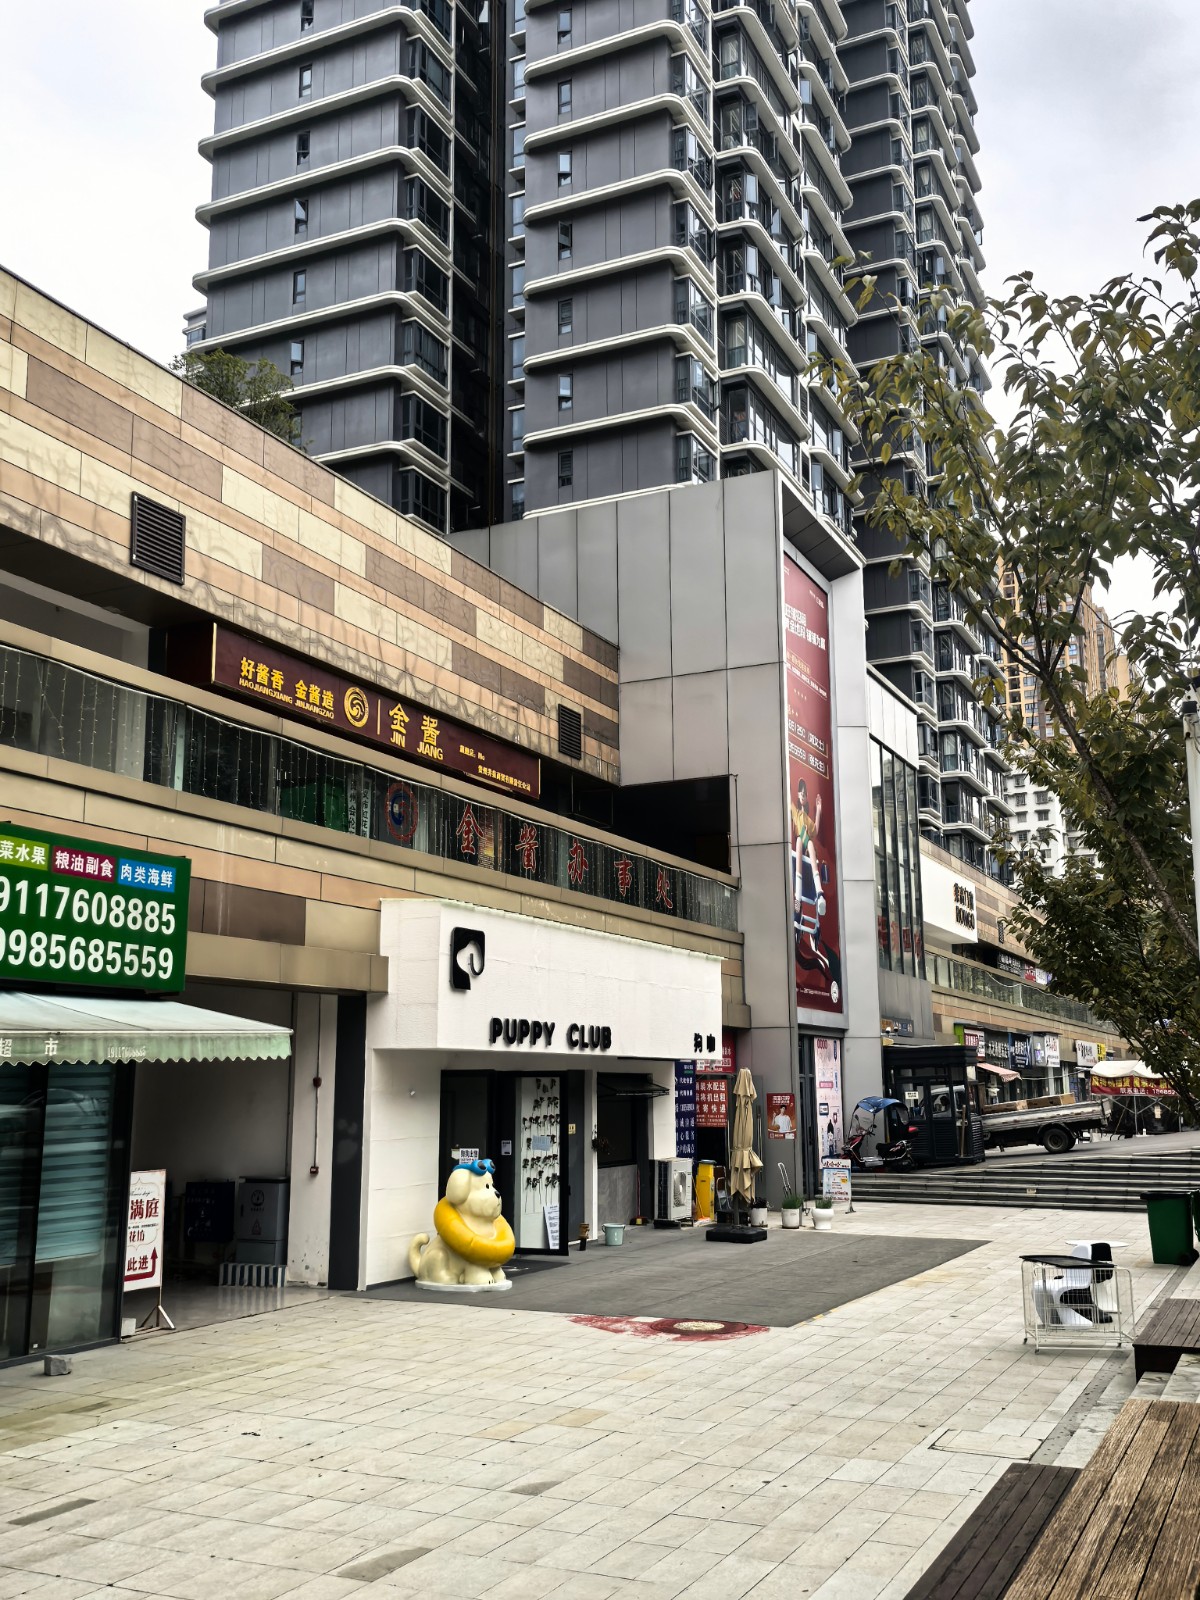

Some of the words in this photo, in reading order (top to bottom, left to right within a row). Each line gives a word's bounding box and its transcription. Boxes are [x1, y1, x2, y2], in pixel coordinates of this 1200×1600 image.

[239, 677, 293, 705] HAOJIANGXIANG
[294, 699, 335, 720] JINJIANGZAO
[240, 656, 284, 691] 好酱香
[295, 679, 334, 711] 金酱造
[390, 730, 406, 748] JIN
[416, 741, 444, 760] JIANG
[0, 840, 46, 865] 菜水果
[55, 850, 114, 879] 粮油副食
[120, 863, 174, 889] 肉类海鲜
[489, 1017, 556, 1047] PUPPY
[566, 1022, 612, 1050] CLUB
[129, 1198, 160, 1220] 满庭
